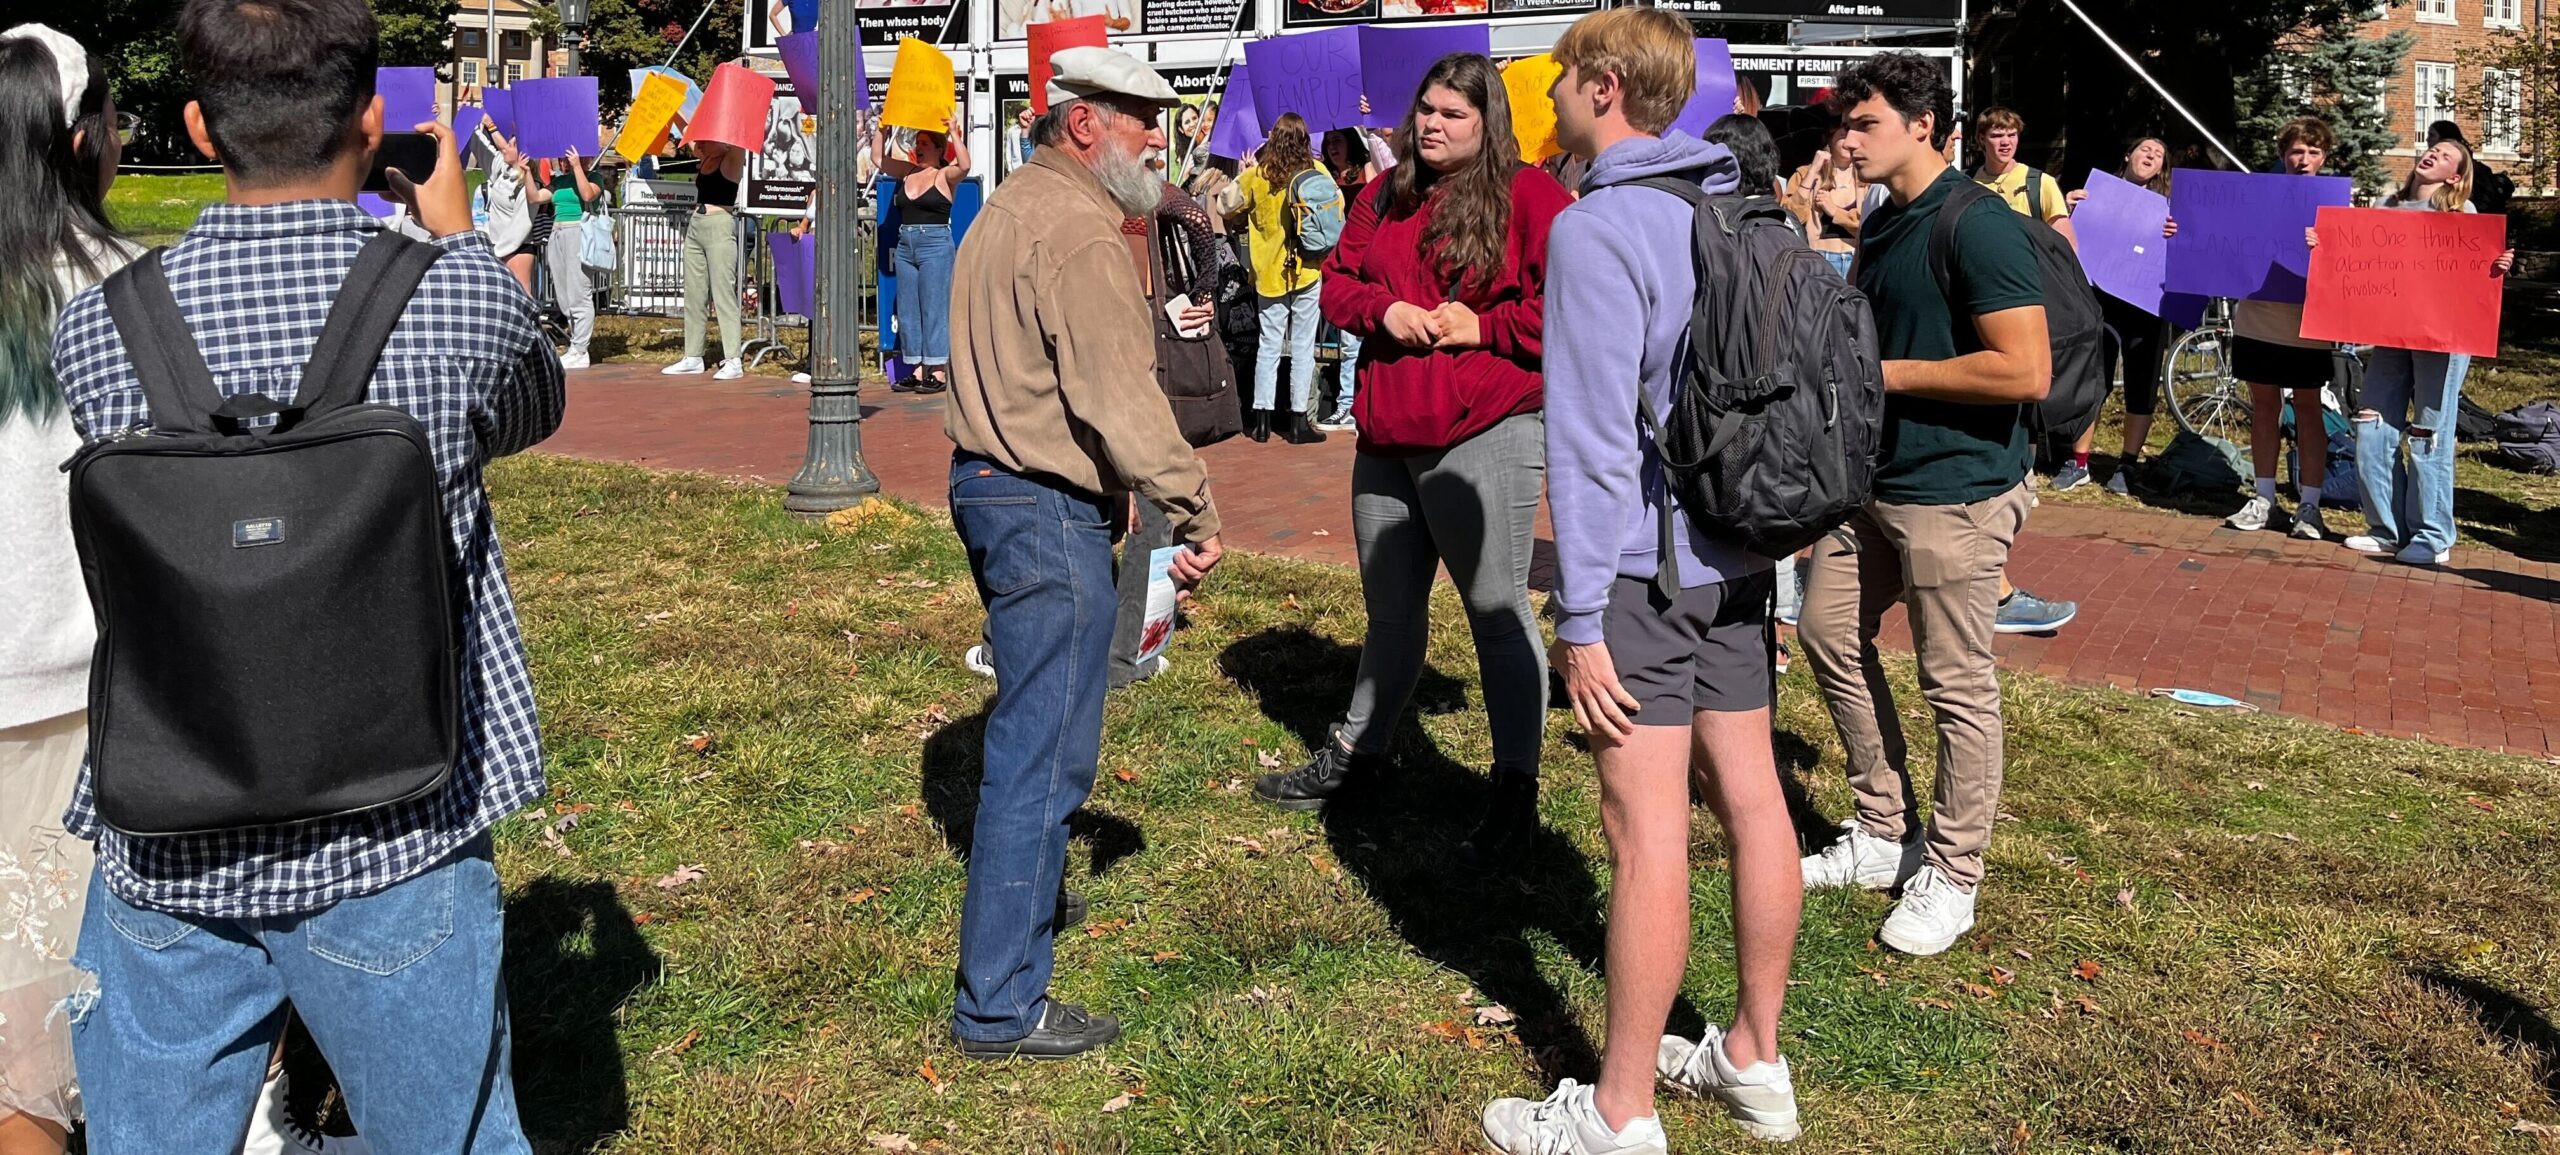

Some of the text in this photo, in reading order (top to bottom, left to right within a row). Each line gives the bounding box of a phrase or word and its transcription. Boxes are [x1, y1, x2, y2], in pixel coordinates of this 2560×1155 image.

[1147, 1, 1175, 9] Aborting
[1165, 8, 1194, 16] butchers
[1195, 6, 1210, 14] who
[1211, 5, 1240, 14] slaughte
[1654, 0, 1721, 11] Before Birth
[1828, 4, 1883, 16] After Birth
[859, 15, 946, 28] Then whose body
[1147, 16, 1169, 24] babies
[1179, 15, 1213, 23] knowingly
[1147, 24, 1166, 32] death
[1186, 22, 1230, 31] exterminator.
[883, 31, 893, 41] is
[1281, 33, 1354, 75] OUR
[1731, 58, 1794, 71] ERNMENT
[1797, 59, 1843, 71] PERMIT
[1800, 77, 1820, 85] FIRST
[1255, 73, 1360, 127] CAMPUS
[2338, 223, 2481, 251] No One thinks
[2335, 251, 2488, 273] abortion is fun or
[2342, 274, 2397, 300] frivolous!
